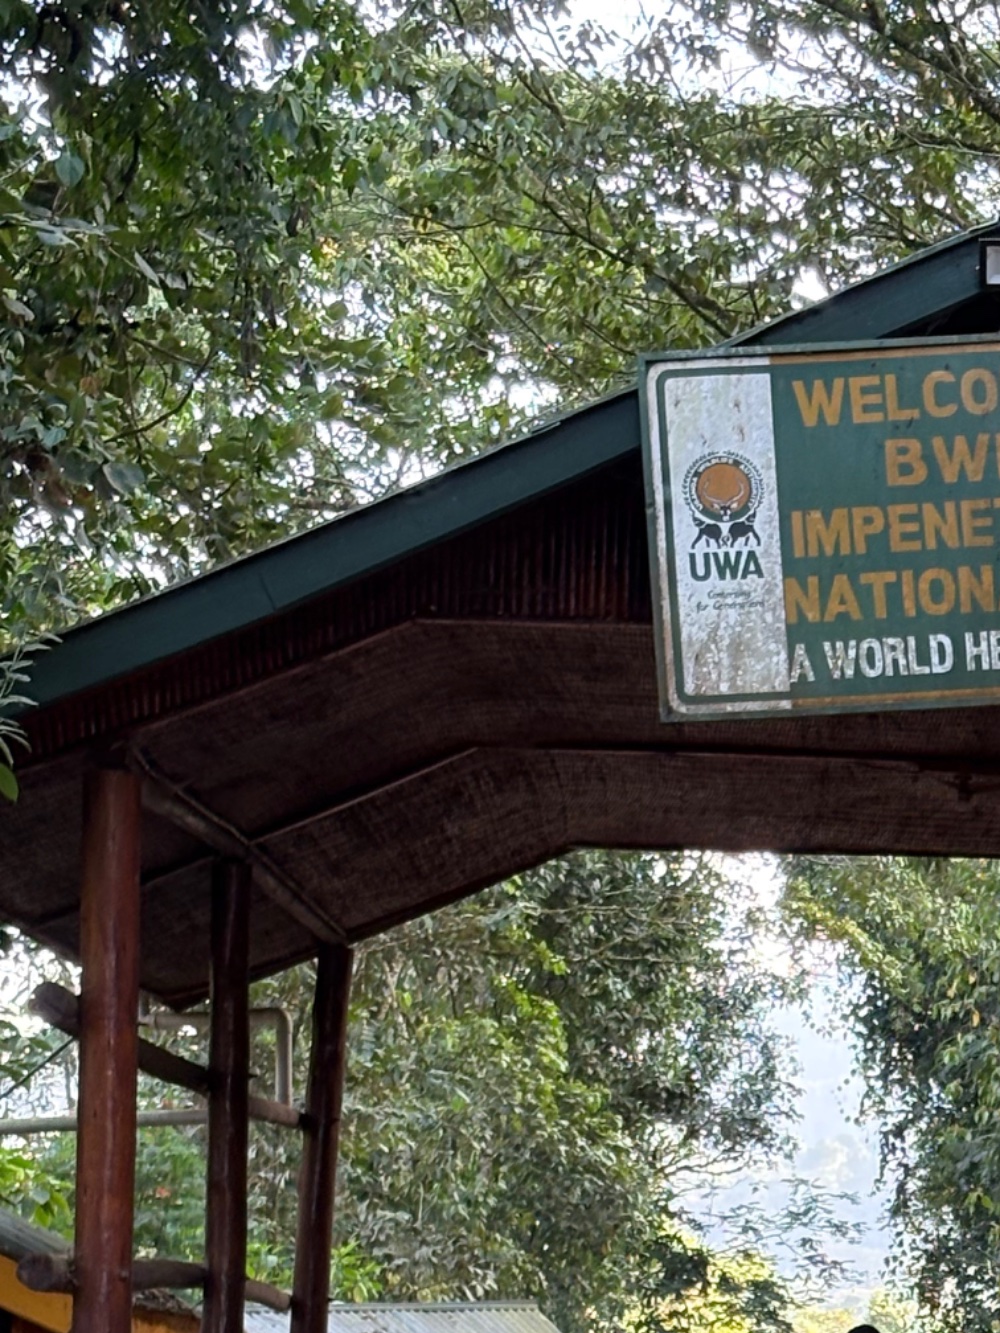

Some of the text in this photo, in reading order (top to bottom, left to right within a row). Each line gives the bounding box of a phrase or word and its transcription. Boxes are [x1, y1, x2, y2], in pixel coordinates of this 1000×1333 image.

[688, 550, 764, 582] UWA
[789, 644, 815, 684] A
[823, 633, 954, 680] WORLD
